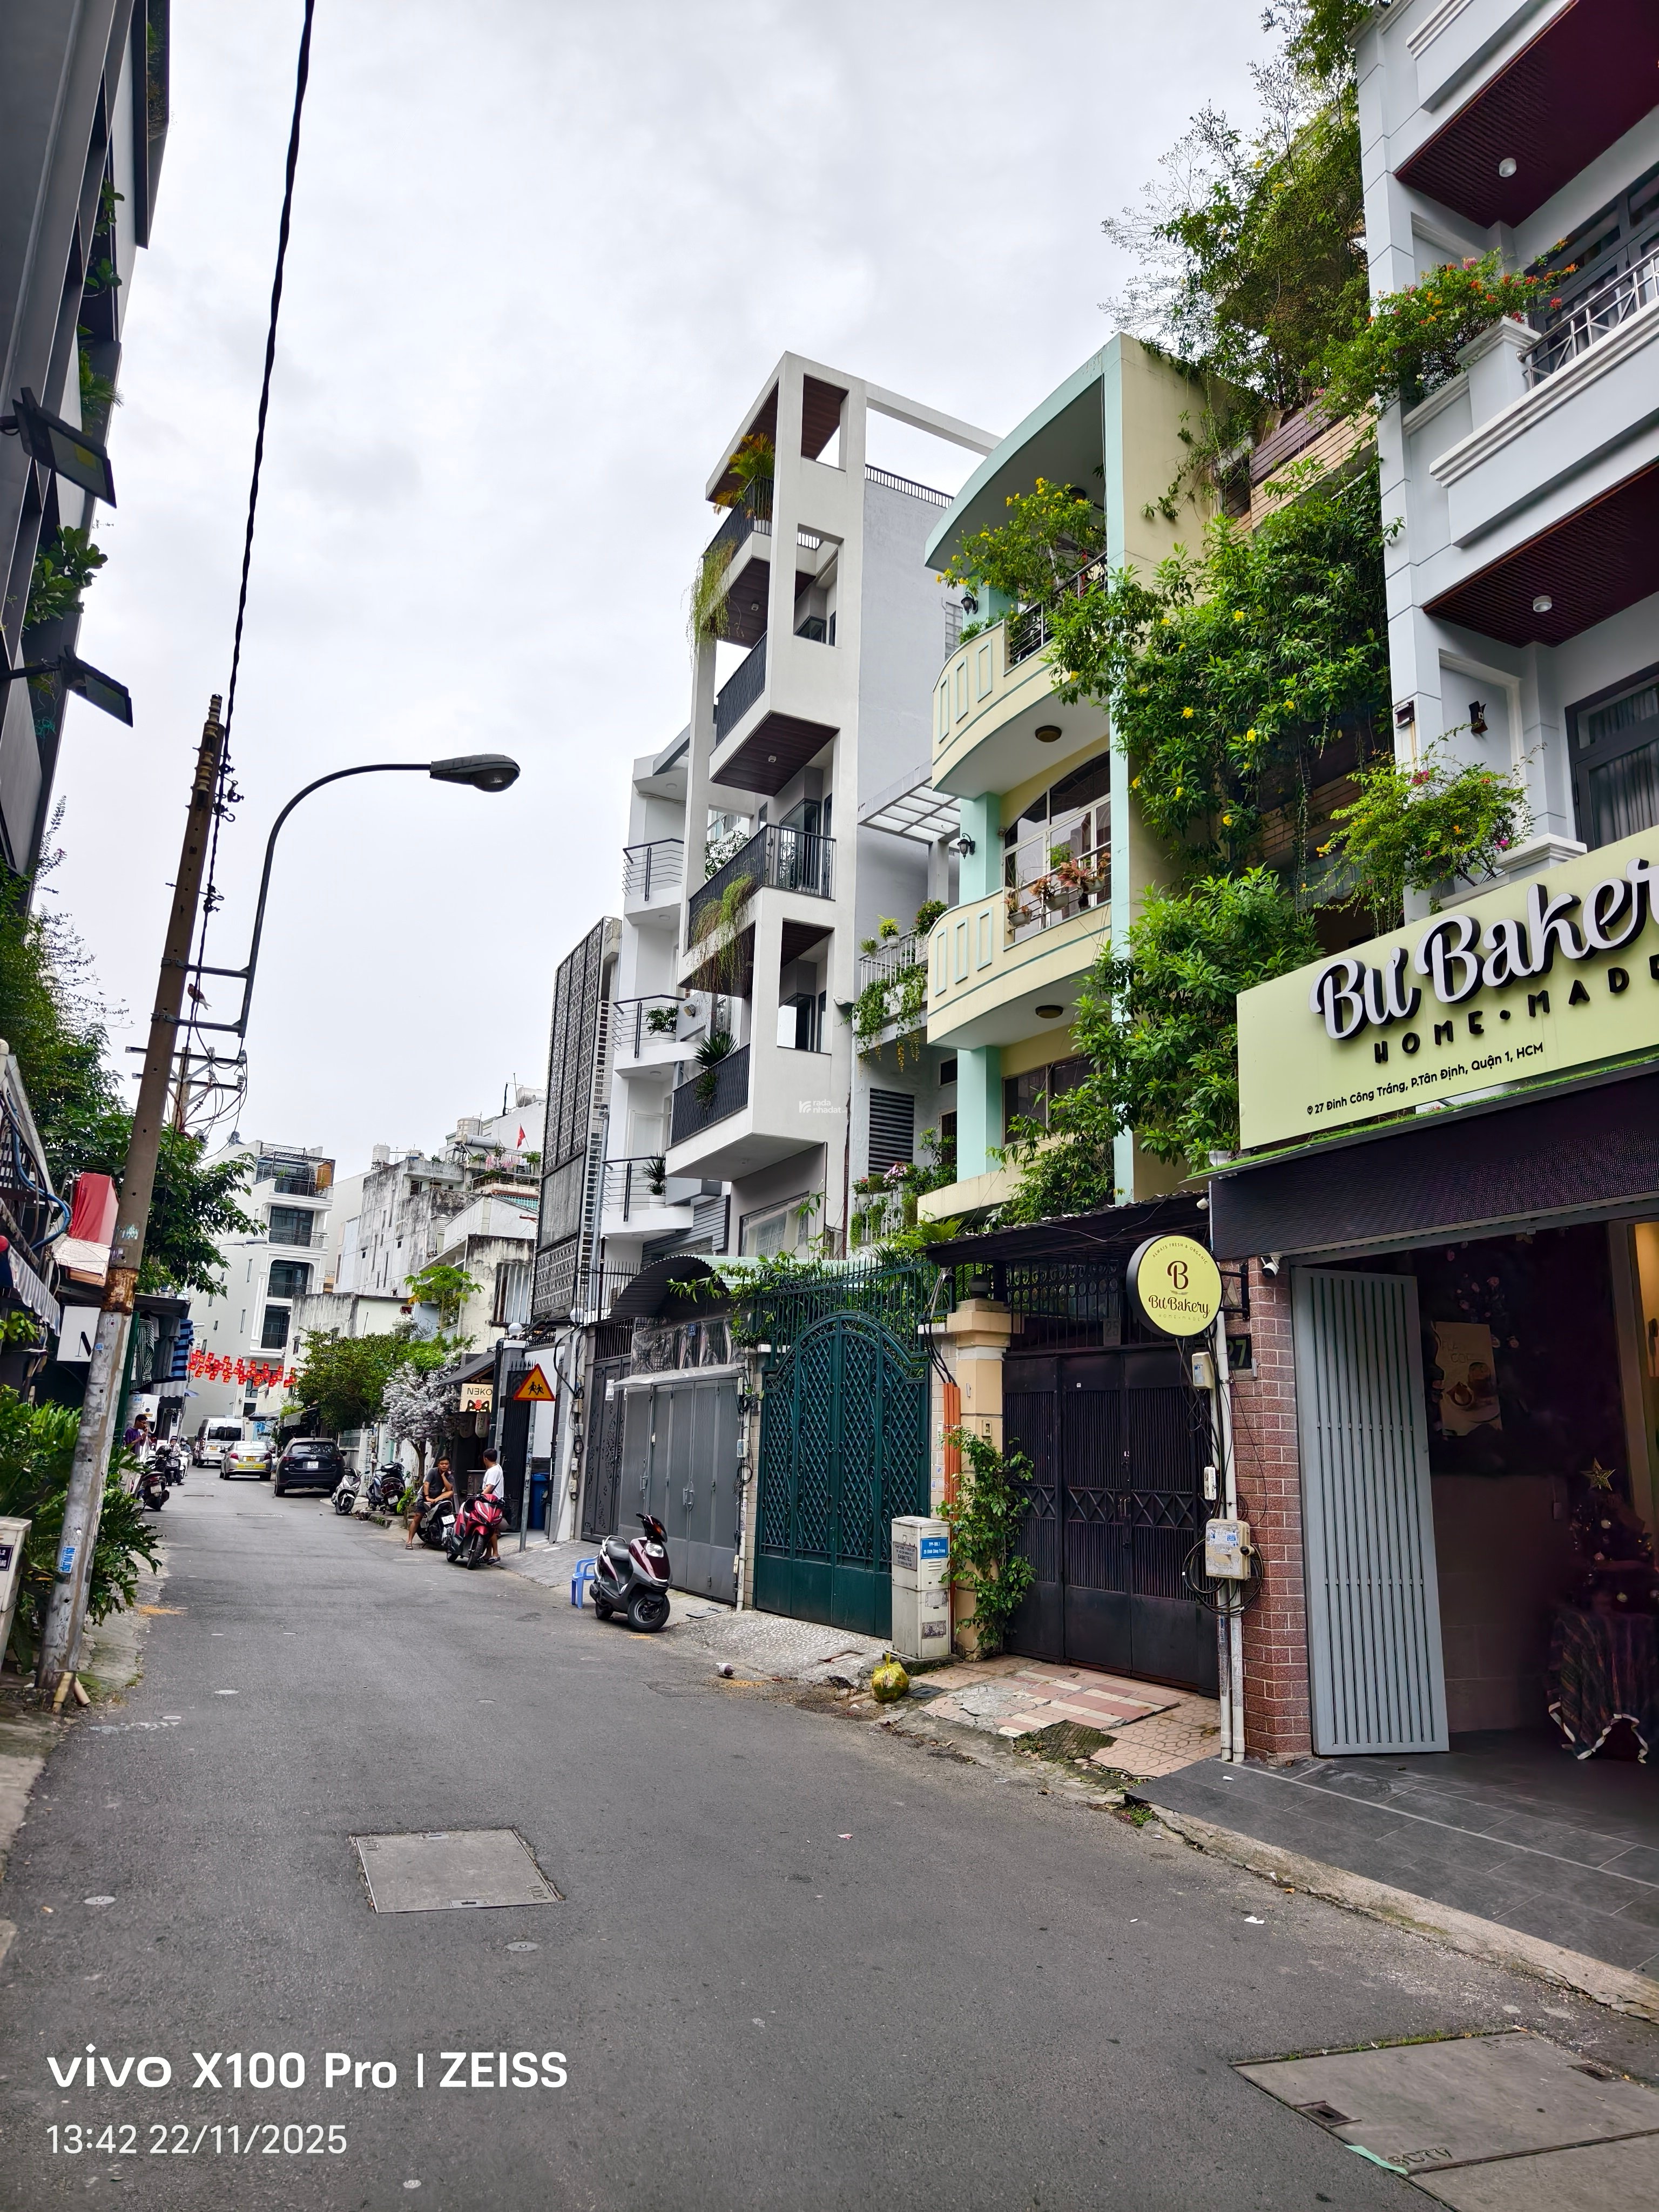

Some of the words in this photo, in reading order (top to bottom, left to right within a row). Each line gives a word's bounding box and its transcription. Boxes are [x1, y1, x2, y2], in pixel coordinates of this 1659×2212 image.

[1309, 947, 1421, 1040] Bư
[1314, 1103, 1324, 1114] 27
[1350, 1091, 1374, 1104] Công
[1377, 1082, 1408, 1097] Tráng,
[1411, 1073, 1438, 1088] P.Tân
[1440, 1064, 1468, 1080] Định,
[1472, 1055, 1502, 1069] Quận
[1516, 1042, 1543, 1059] HCM
[1152, 1245, 1168, 1258] ALWAYS
[1190, 1246, 1208, 1264] ORGANIC
[1167, 1260, 1189, 1290] B
[1168, 1297, 1210, 1319] Bakery
[467, 1387, 493, 1395] NEKO
